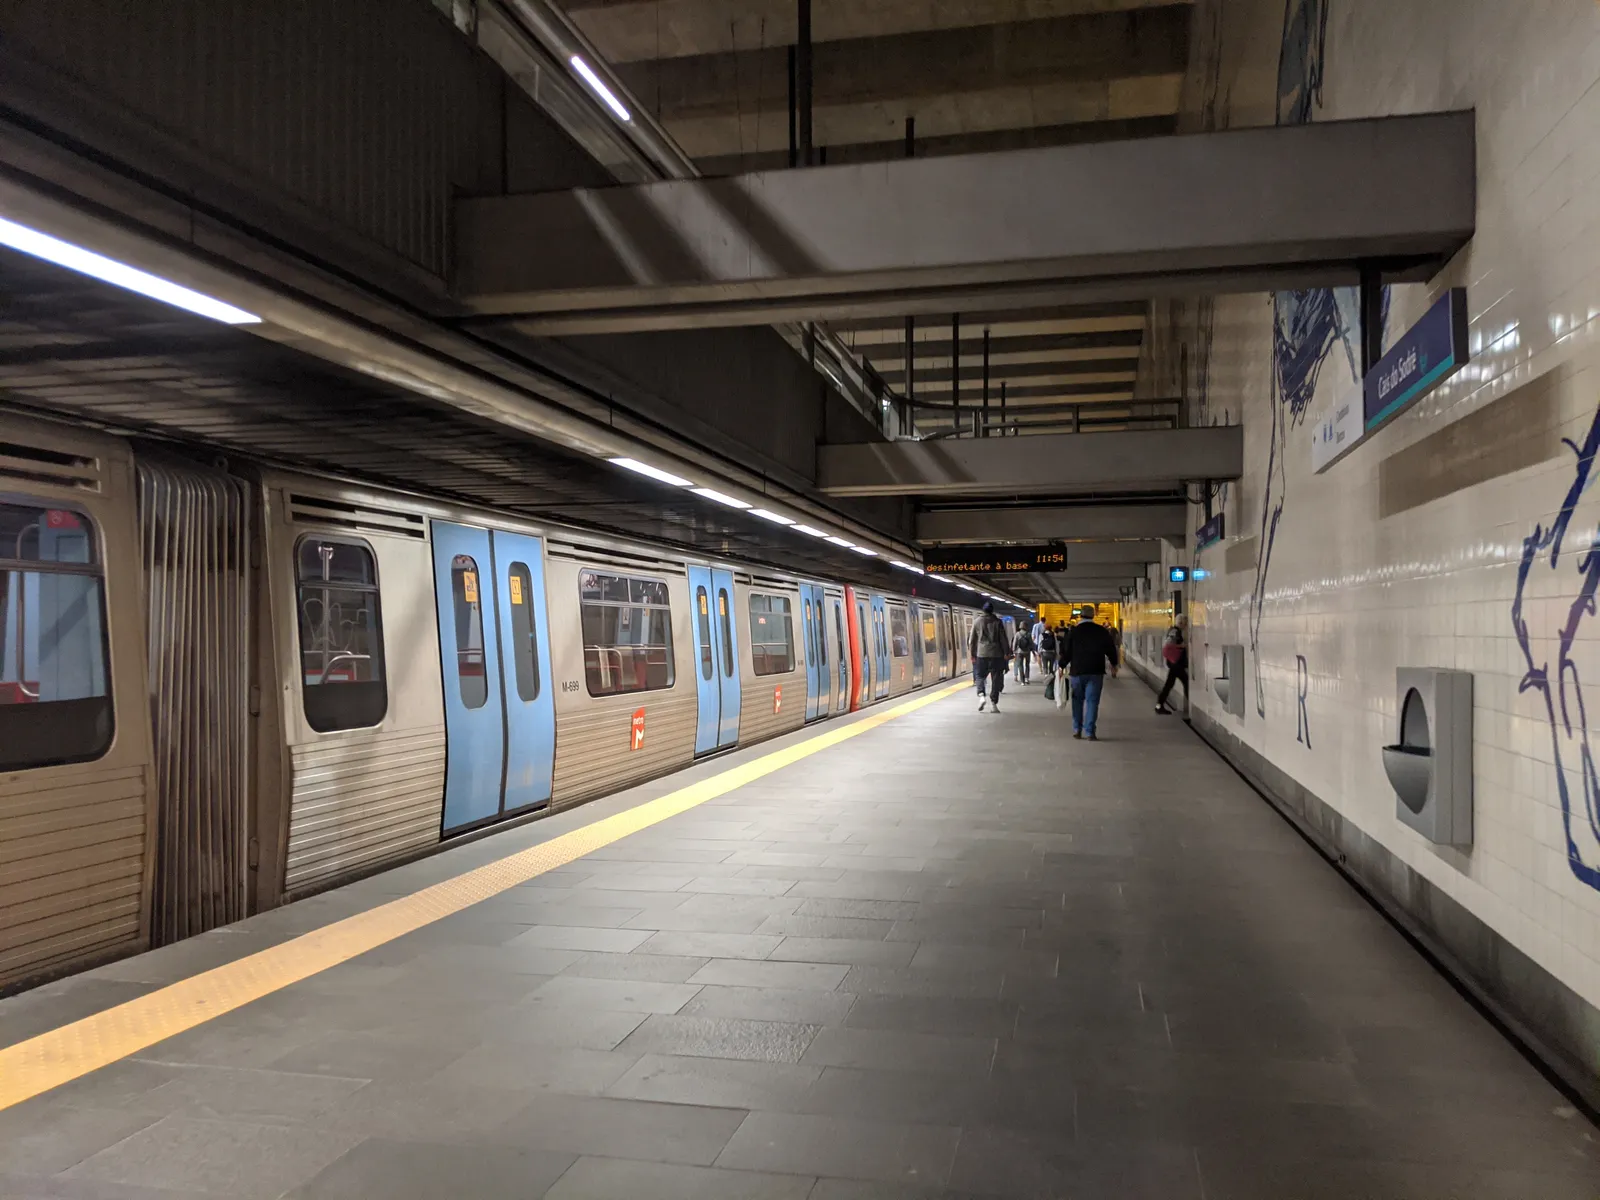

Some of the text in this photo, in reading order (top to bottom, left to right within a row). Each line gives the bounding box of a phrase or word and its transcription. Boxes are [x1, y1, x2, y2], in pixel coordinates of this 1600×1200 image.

[1378, 346, 1417, 400] Cais do Sodré
[1036, 554, 1064, 563] 11:54
[926, 562, 1029, 572] desinfetante à base
[562, 680, 580, 693] M-699
